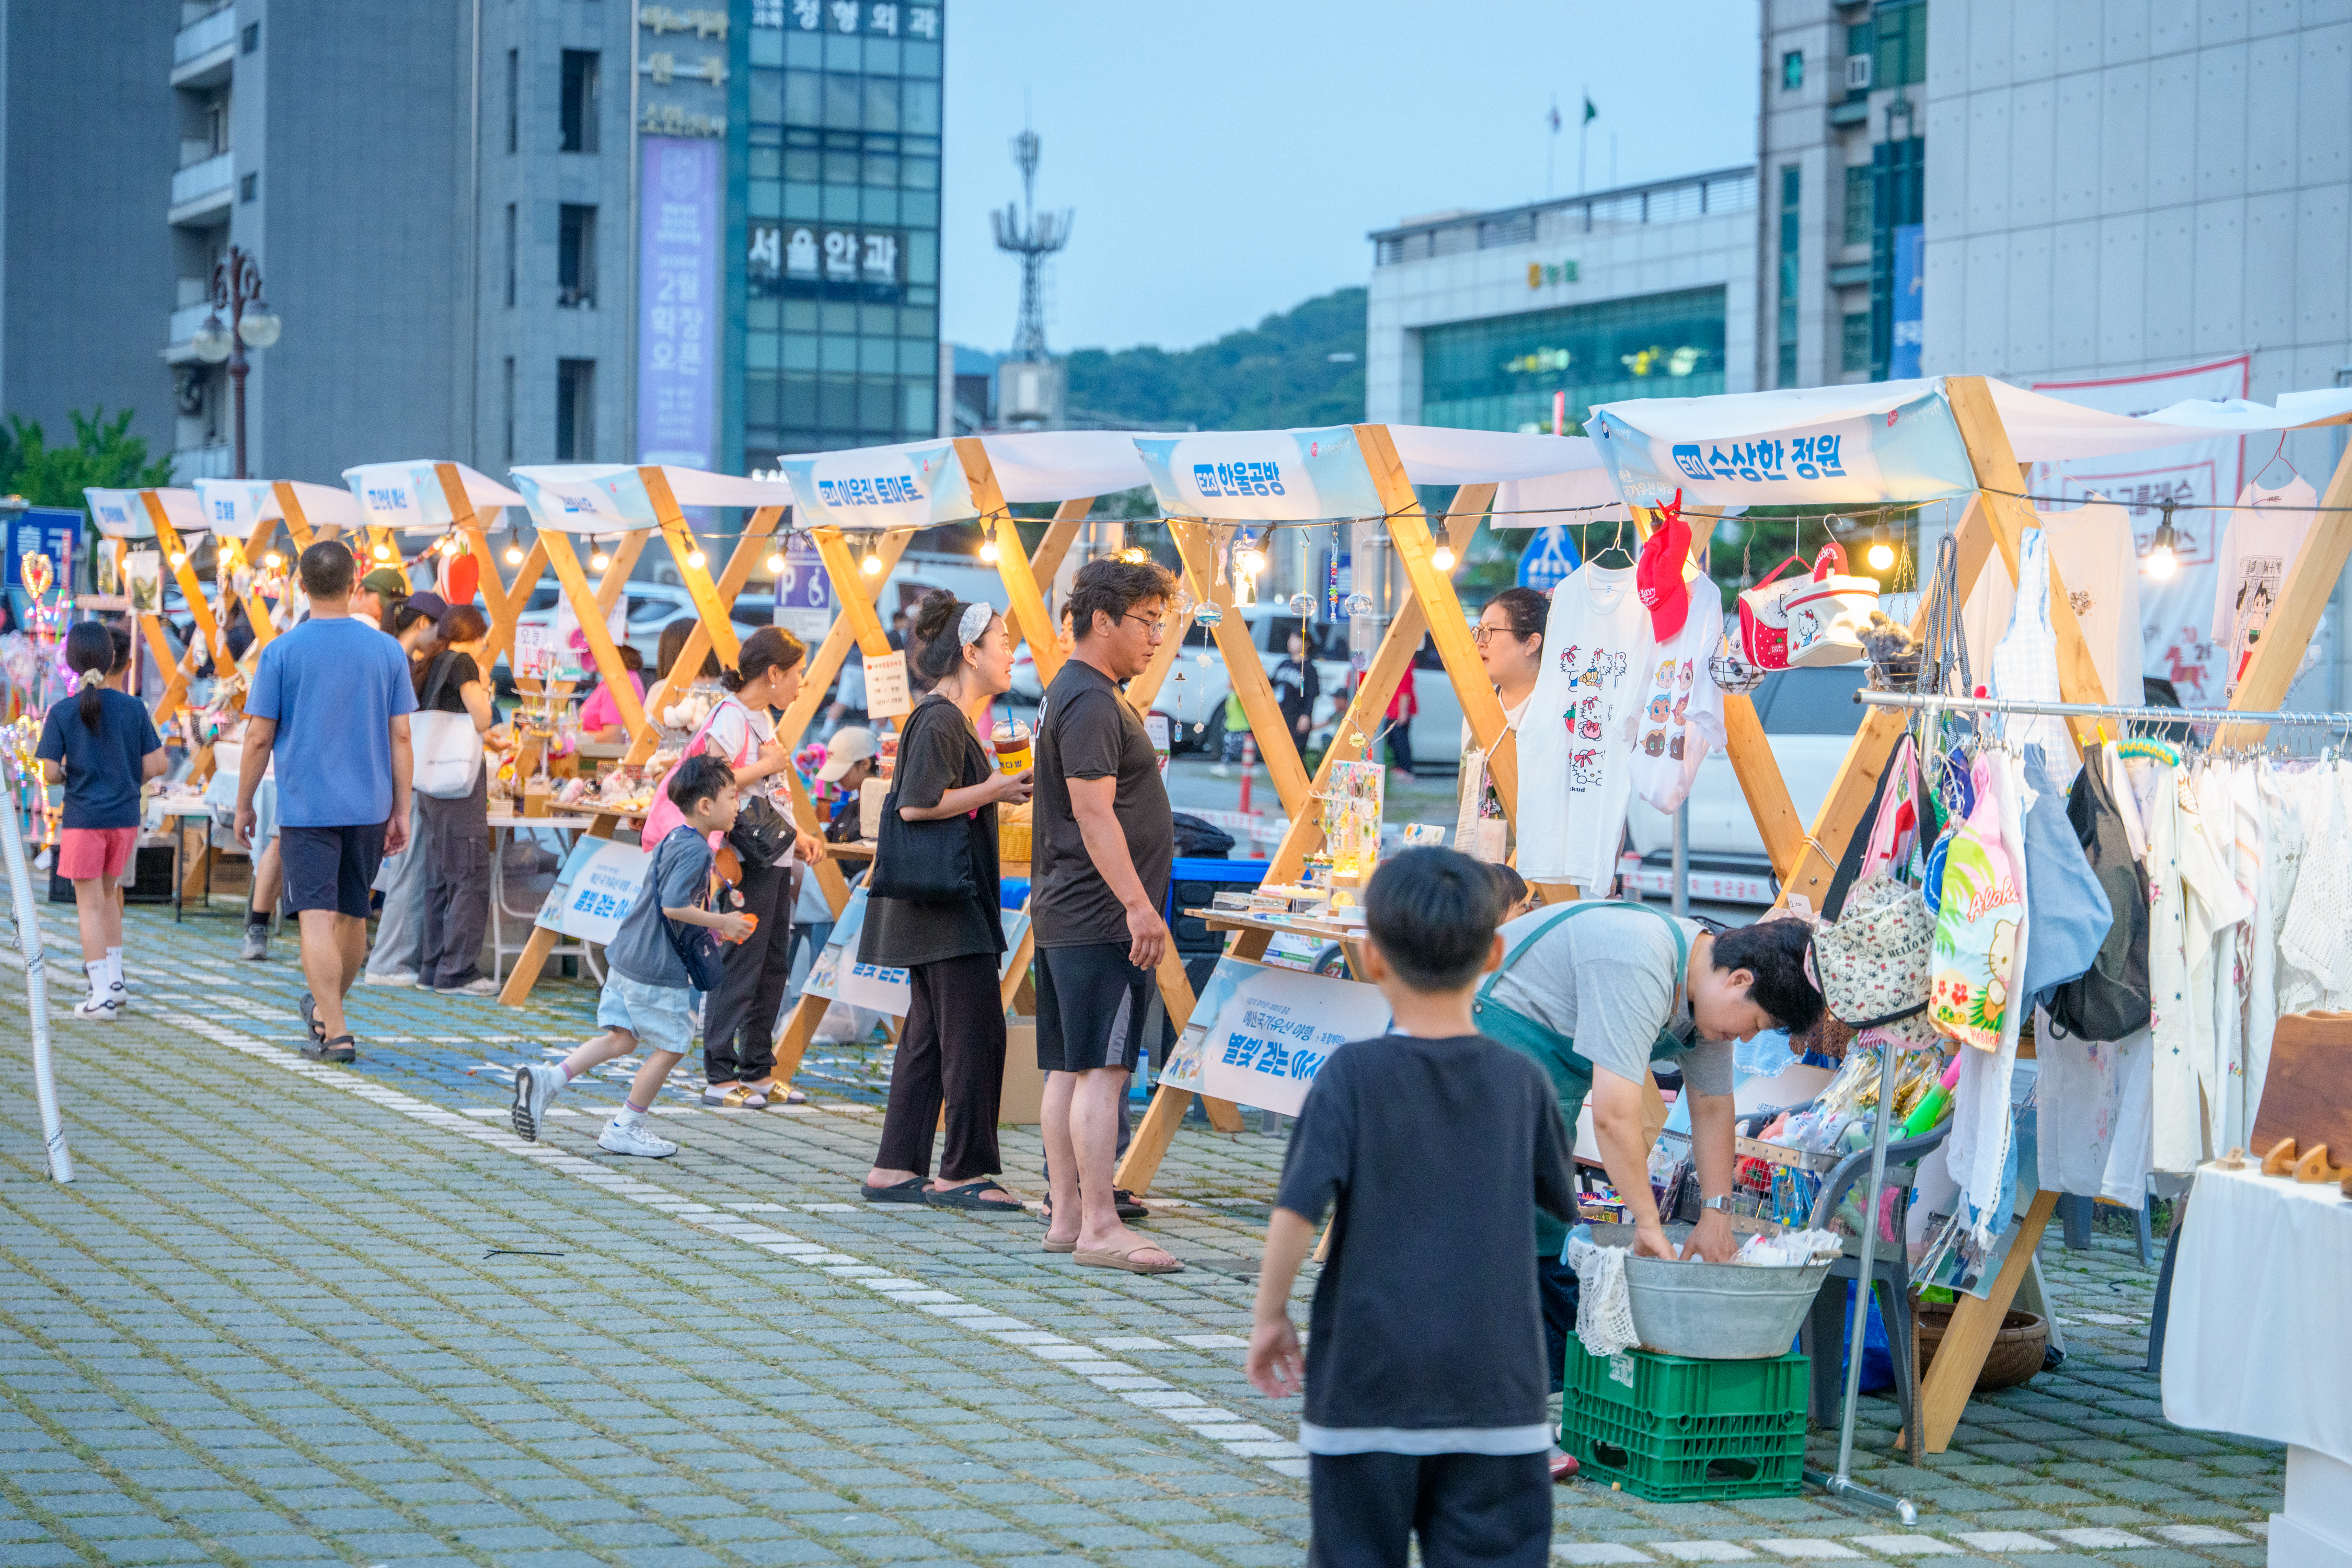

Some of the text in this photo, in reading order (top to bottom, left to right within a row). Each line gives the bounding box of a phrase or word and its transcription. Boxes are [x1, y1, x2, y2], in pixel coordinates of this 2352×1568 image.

[748, 226, 898, 278] 서울안과
[1708, 439, 1789, 482] 수상한
[1791, 434, 1848, 480] 정원
[837, 478, 880, 506] 이웃집
[874, 475, 925, 505] 토마토
[1217, 462, 1286, 497] 한울공방
[1814, 548, 1838, 573] HELLO KITTY
[781, 566, 797, 606] P
[1888, 927, 1936, 958] HELLO KIT
[1292, 1023, 1316, 1041] 야행
[1221, 1032, 1264, 1069] 별빛
[1254, 1041, 1289, 1077] 걷는
